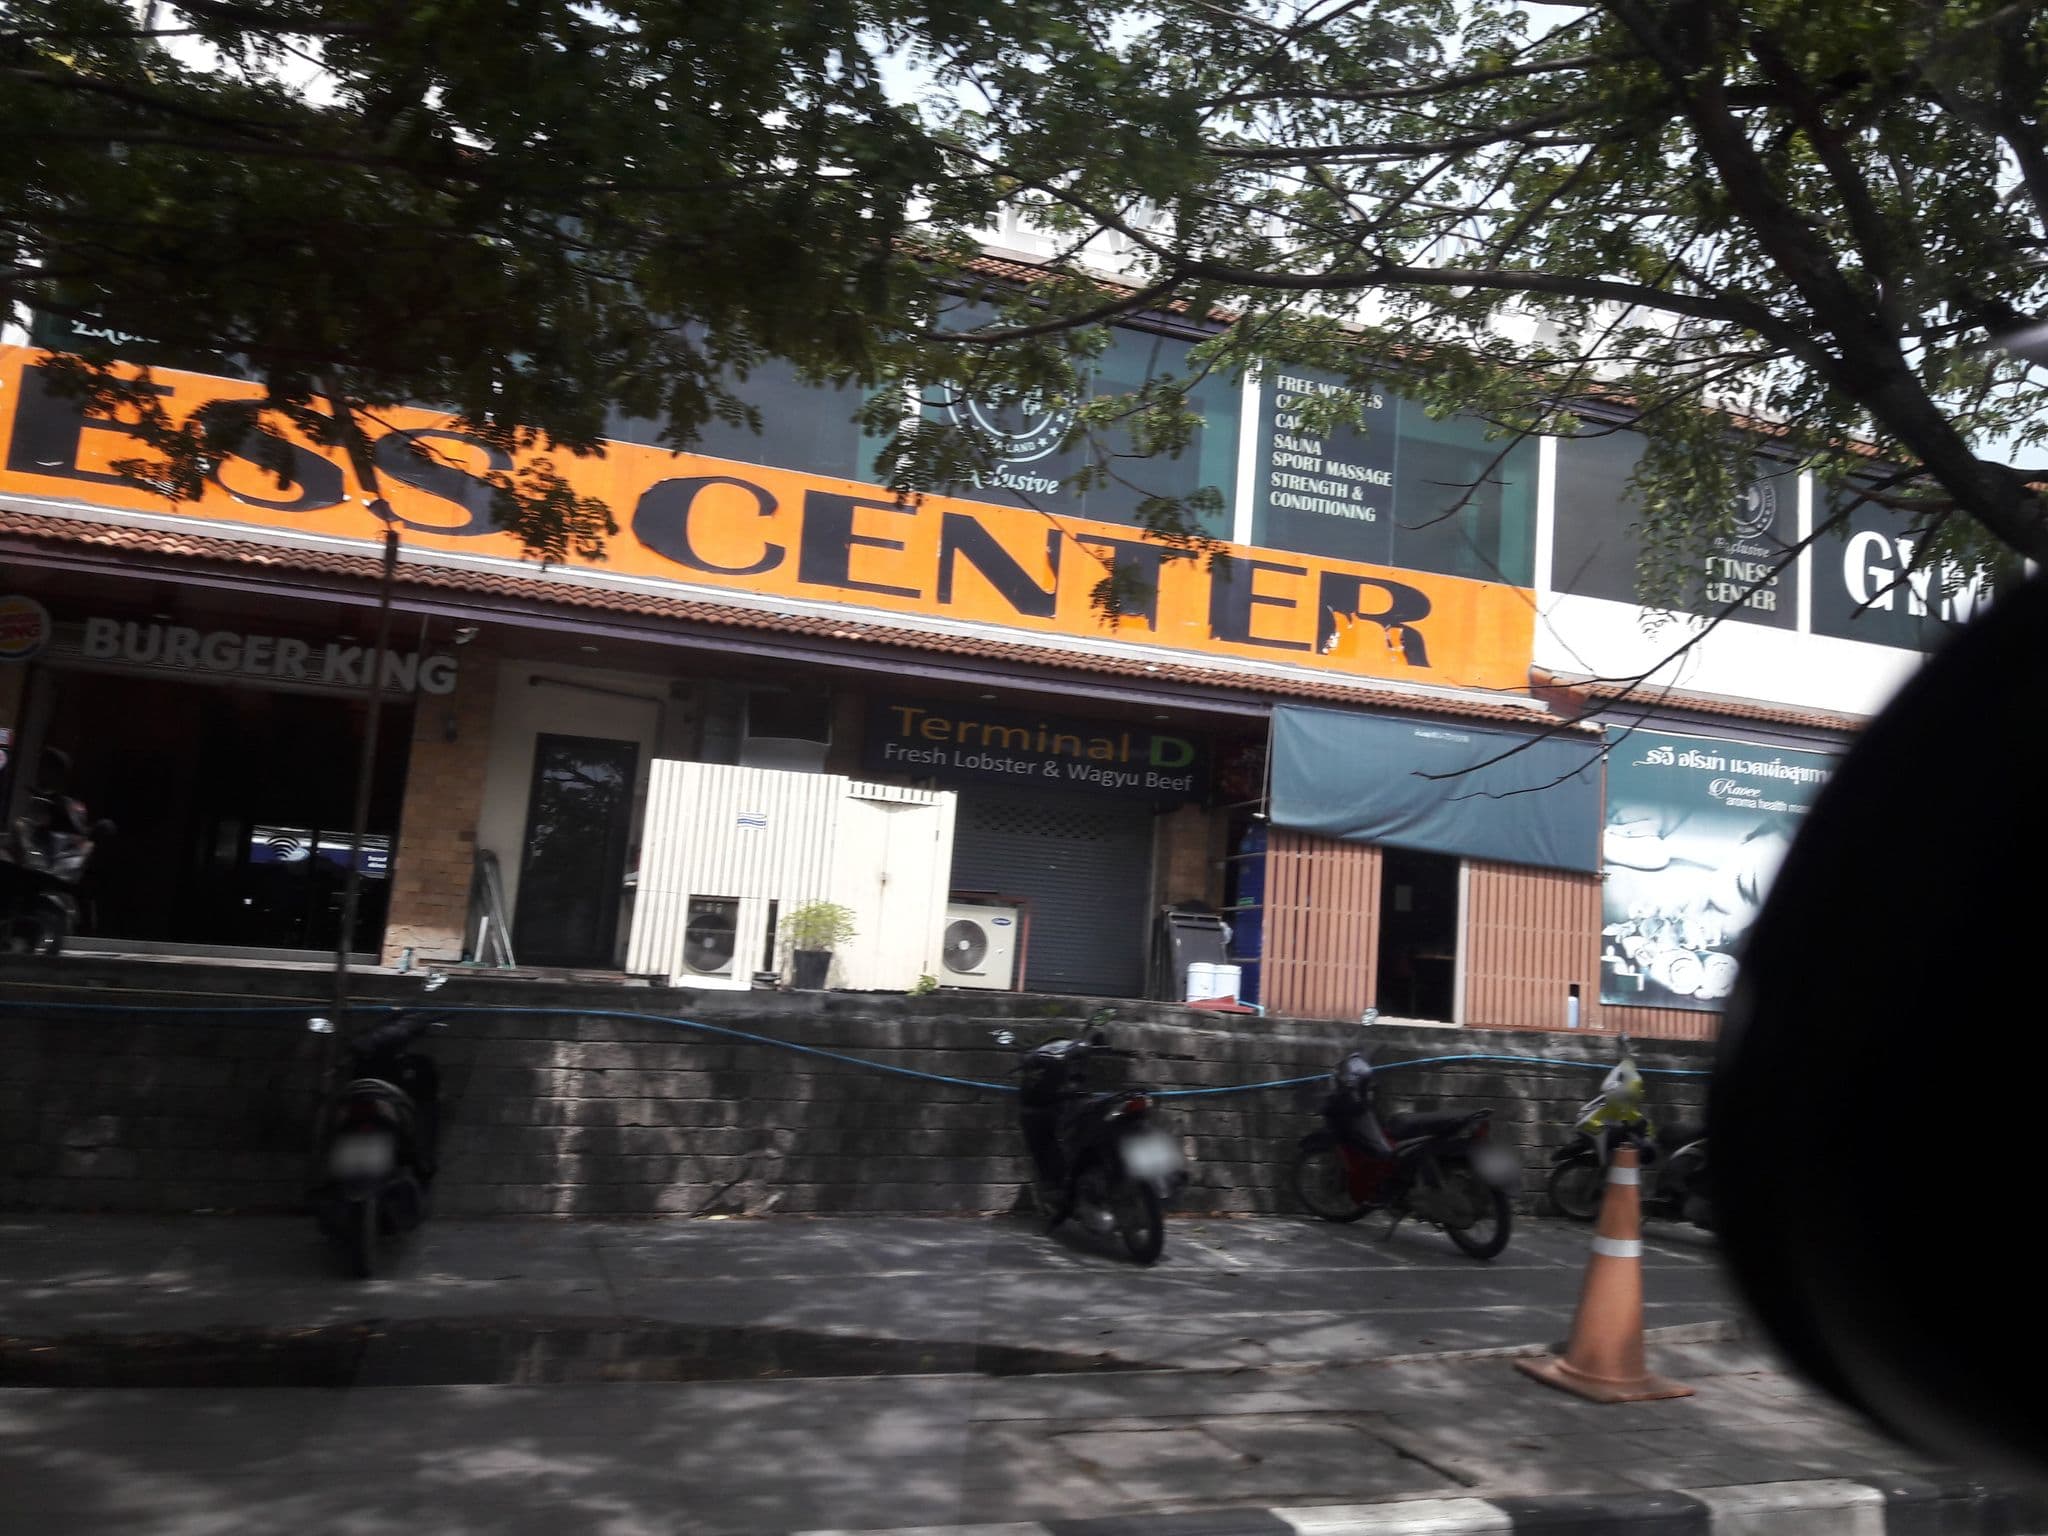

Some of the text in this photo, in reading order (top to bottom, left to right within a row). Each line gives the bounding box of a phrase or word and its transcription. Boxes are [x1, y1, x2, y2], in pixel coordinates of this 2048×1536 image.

[1276, 374, 1314, 397] FREE
[1273, 433, 1322, 456] SAUNA
[1272, 451, 1393, 487] SPORT MASSAGE
[1271, 471, 1364, 501] STRENGTH &
[1270, 491, 1377, 522] CONDITIONING
[632, 476, 1432, 668] CENTER
[1705, 556, 1779, 587] FTNESS
[84, 616, 309, 680] BURGER
[322, 643, 460, 696] KING
[891, 706, 1196, 768] Terminal D
[884, 743, 1194, 792] Fresh Lobster & Wagyu Beef
